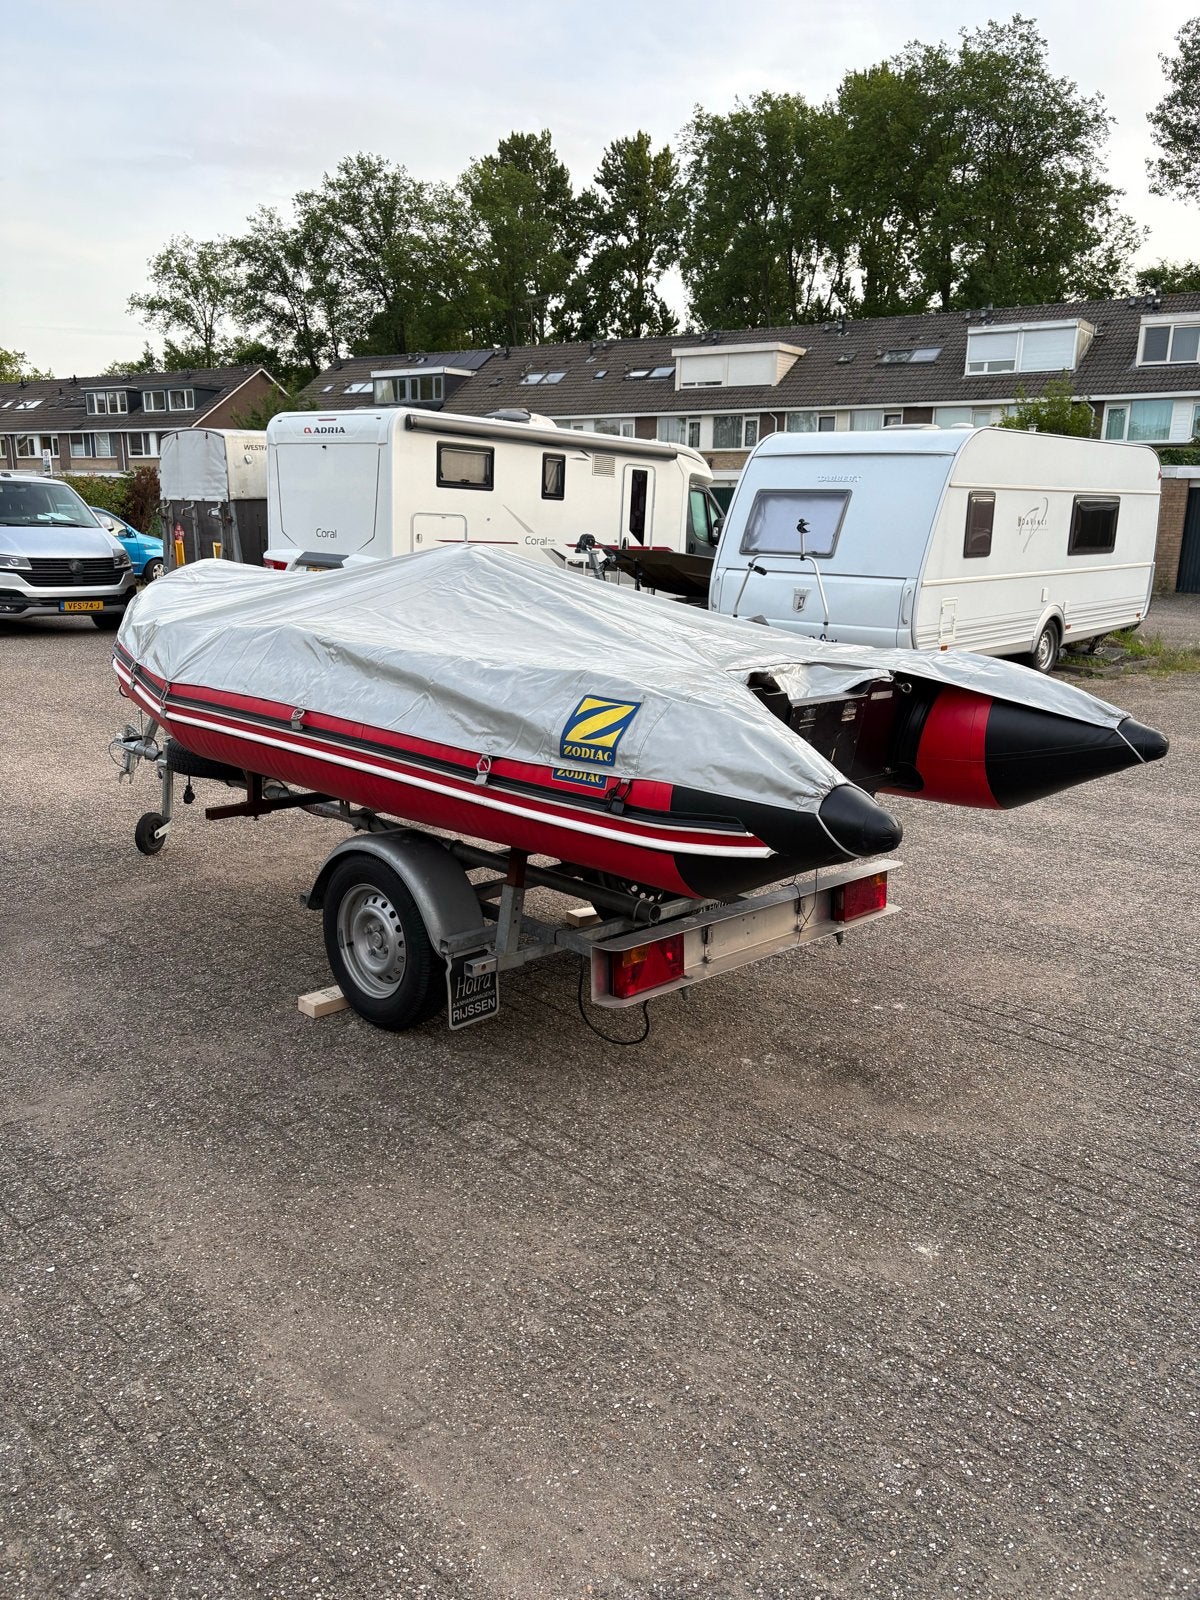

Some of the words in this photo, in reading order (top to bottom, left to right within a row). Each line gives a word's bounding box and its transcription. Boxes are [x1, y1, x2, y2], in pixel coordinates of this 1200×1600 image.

[316, 528, 337, 538] Coral
[525, 536, 547, 545] Coral
[563, 744, 613, 762] ZODIAC
[452, 997, 496, 1023] RIJSSEN
